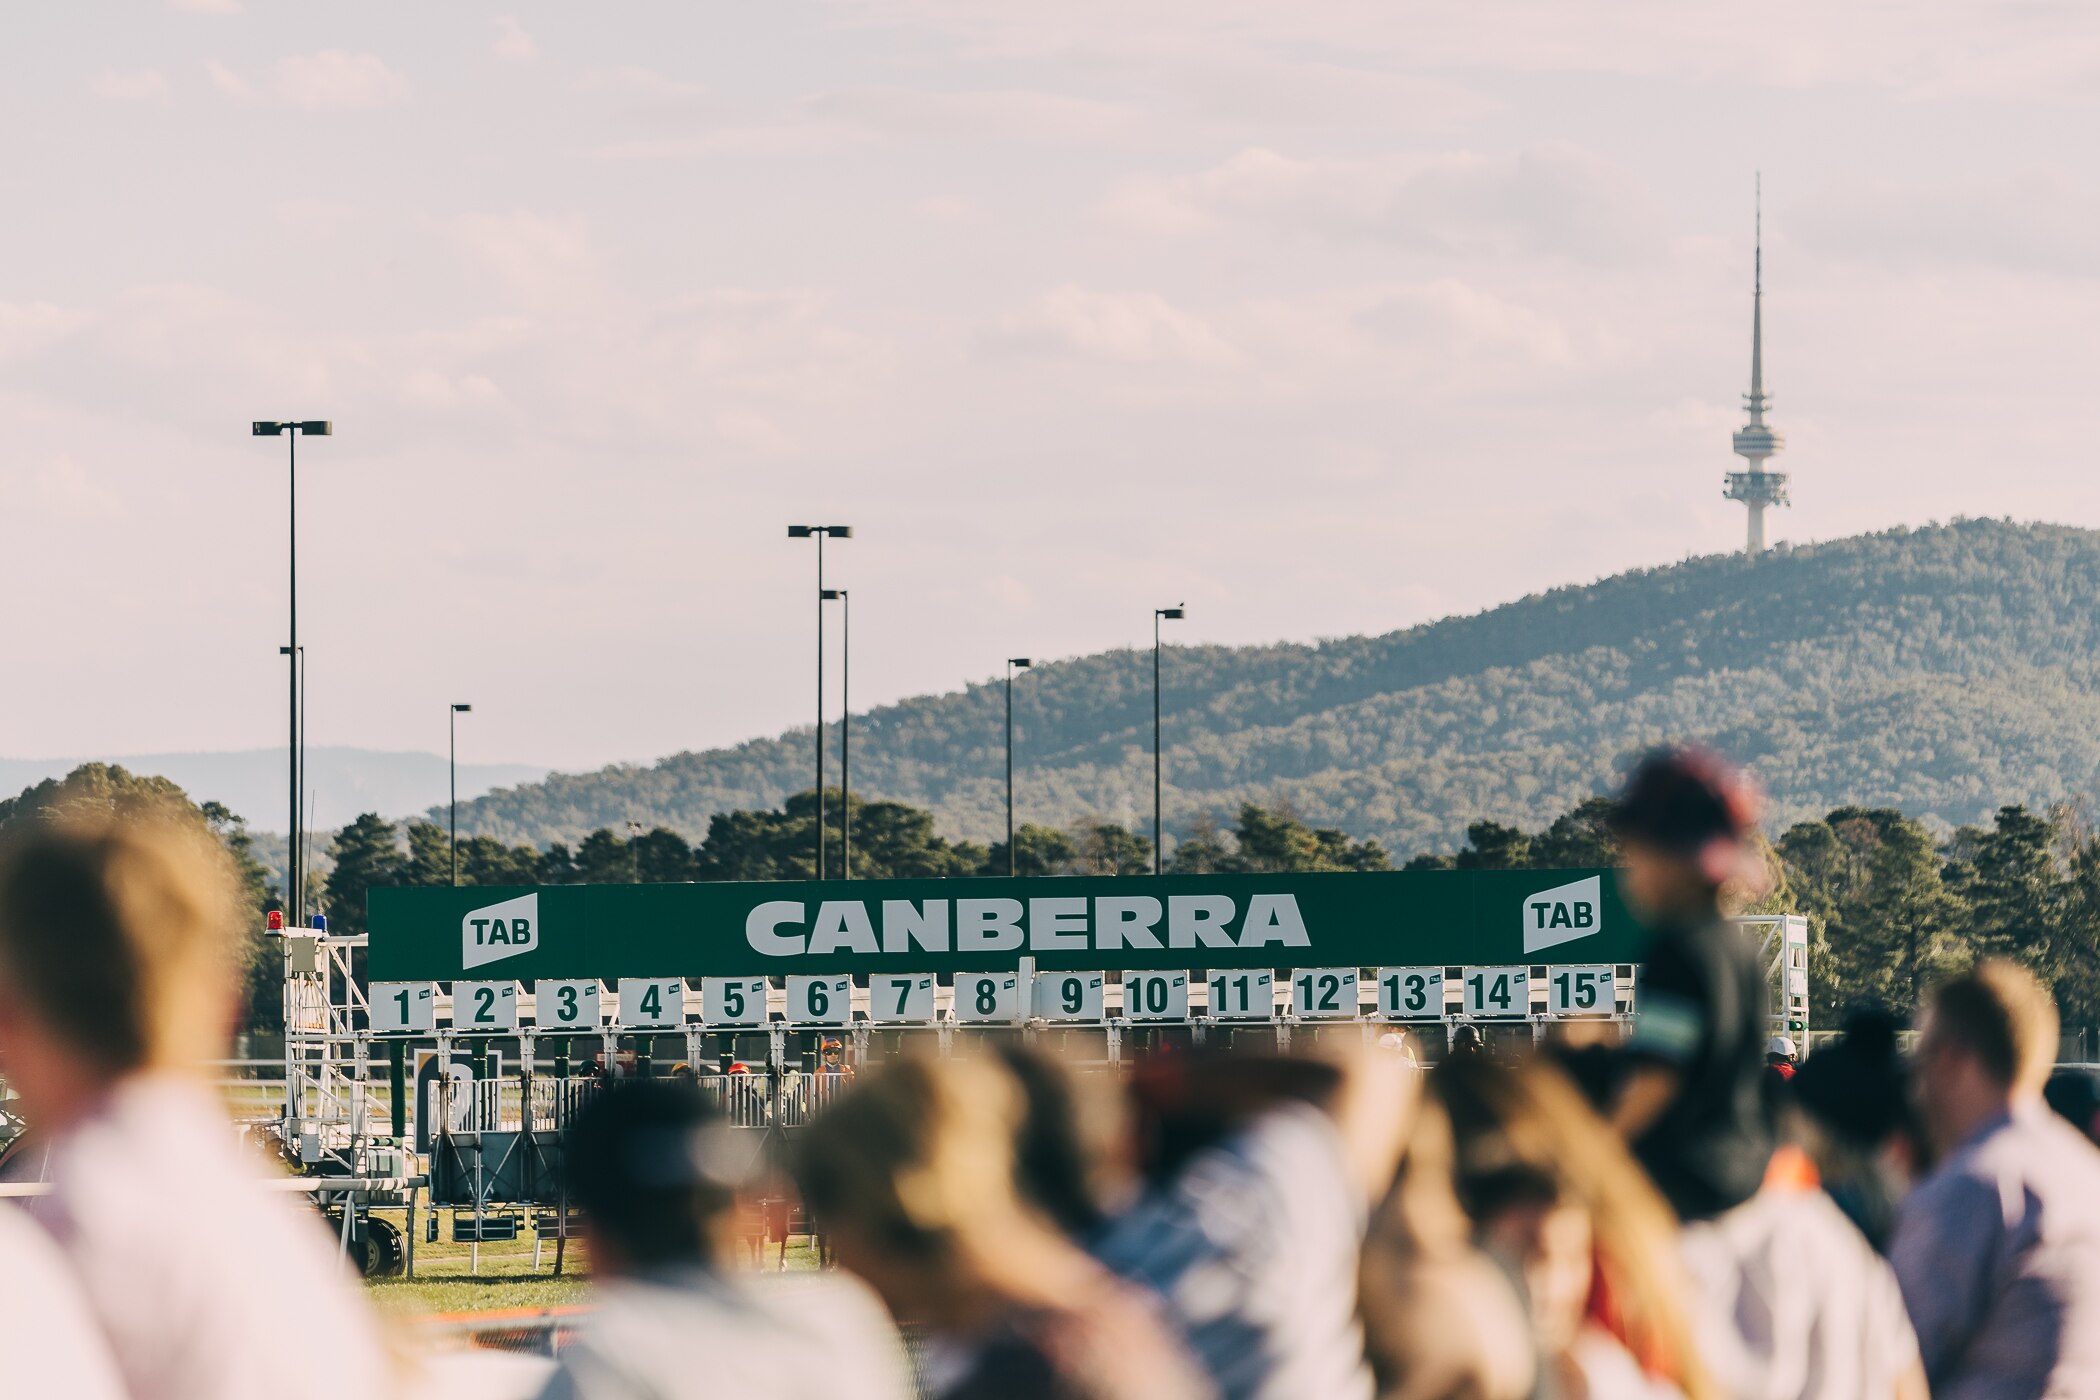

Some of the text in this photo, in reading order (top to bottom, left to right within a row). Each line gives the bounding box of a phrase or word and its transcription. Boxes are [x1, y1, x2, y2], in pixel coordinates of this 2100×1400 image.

[470, 919, 531, 945] TAB
[745, 894, 1311, 956] CANBERRA
[1531, 902, 1594, 929] TAB
[394, 990, 409, 1024] 1
[474, 988, 495, 1023] 2
[557, 986, 578, 1021] 3
[640, 985, 662, 1019] 4
[724, 982, 744, 1018] 5
[808, 981, 828, 1016] 6
[891, 980, 912, 1014] 7
[976, 979, 996, 1015] 8
[1062, 978, 1083, 1014] 9
[1126, 977, 1168, 1013] 10
[1211, 976, 1248, 1011] 11
[1297, 975, 1339, 1010] 12
[1383, 975, 1426, 1011] 13
[1468, 974, 1511, 1009] 14
[1554, 973, 1596, 1008] 15
